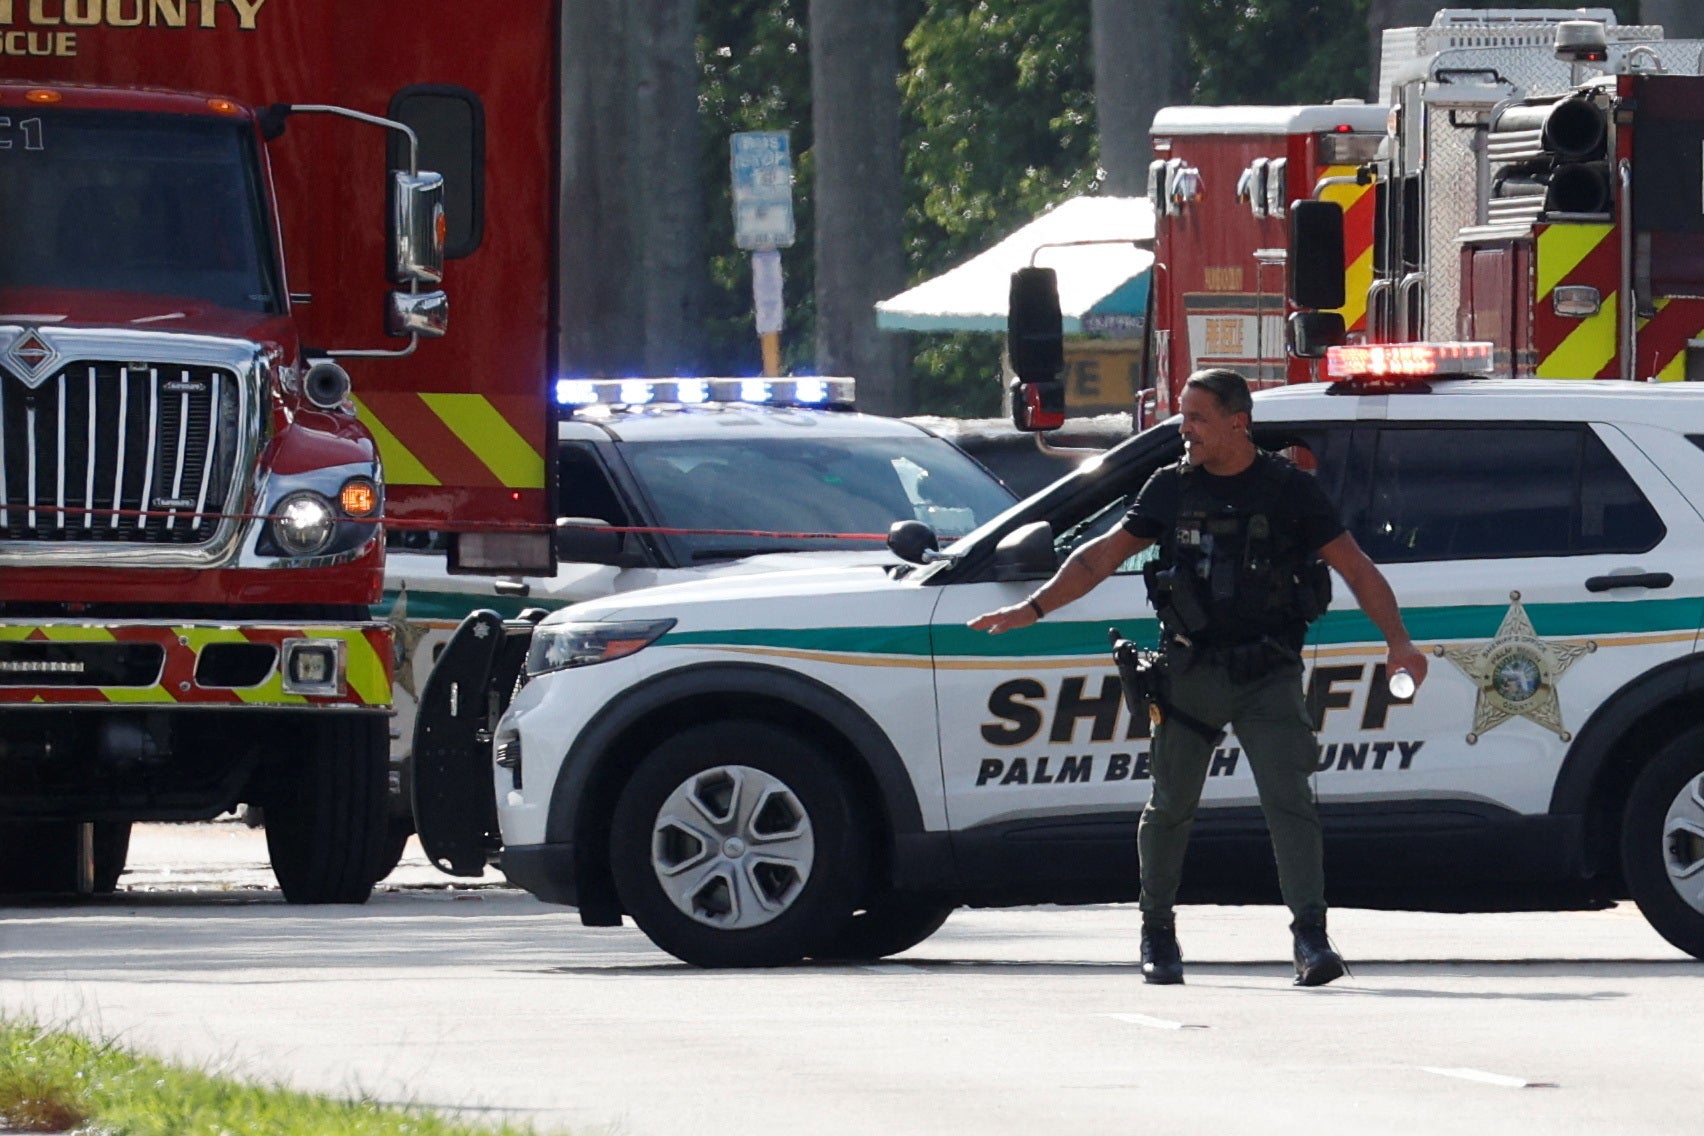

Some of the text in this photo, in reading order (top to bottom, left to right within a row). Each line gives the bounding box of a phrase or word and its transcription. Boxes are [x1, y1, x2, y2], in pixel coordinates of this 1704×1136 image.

[29, 0, 265, 30] COUNTY
[0, 31, 77, 56] CUE
[980, 662, 1420, 748] SHFF
[975, 740, 1425, 786] PALM BEH UNTY
